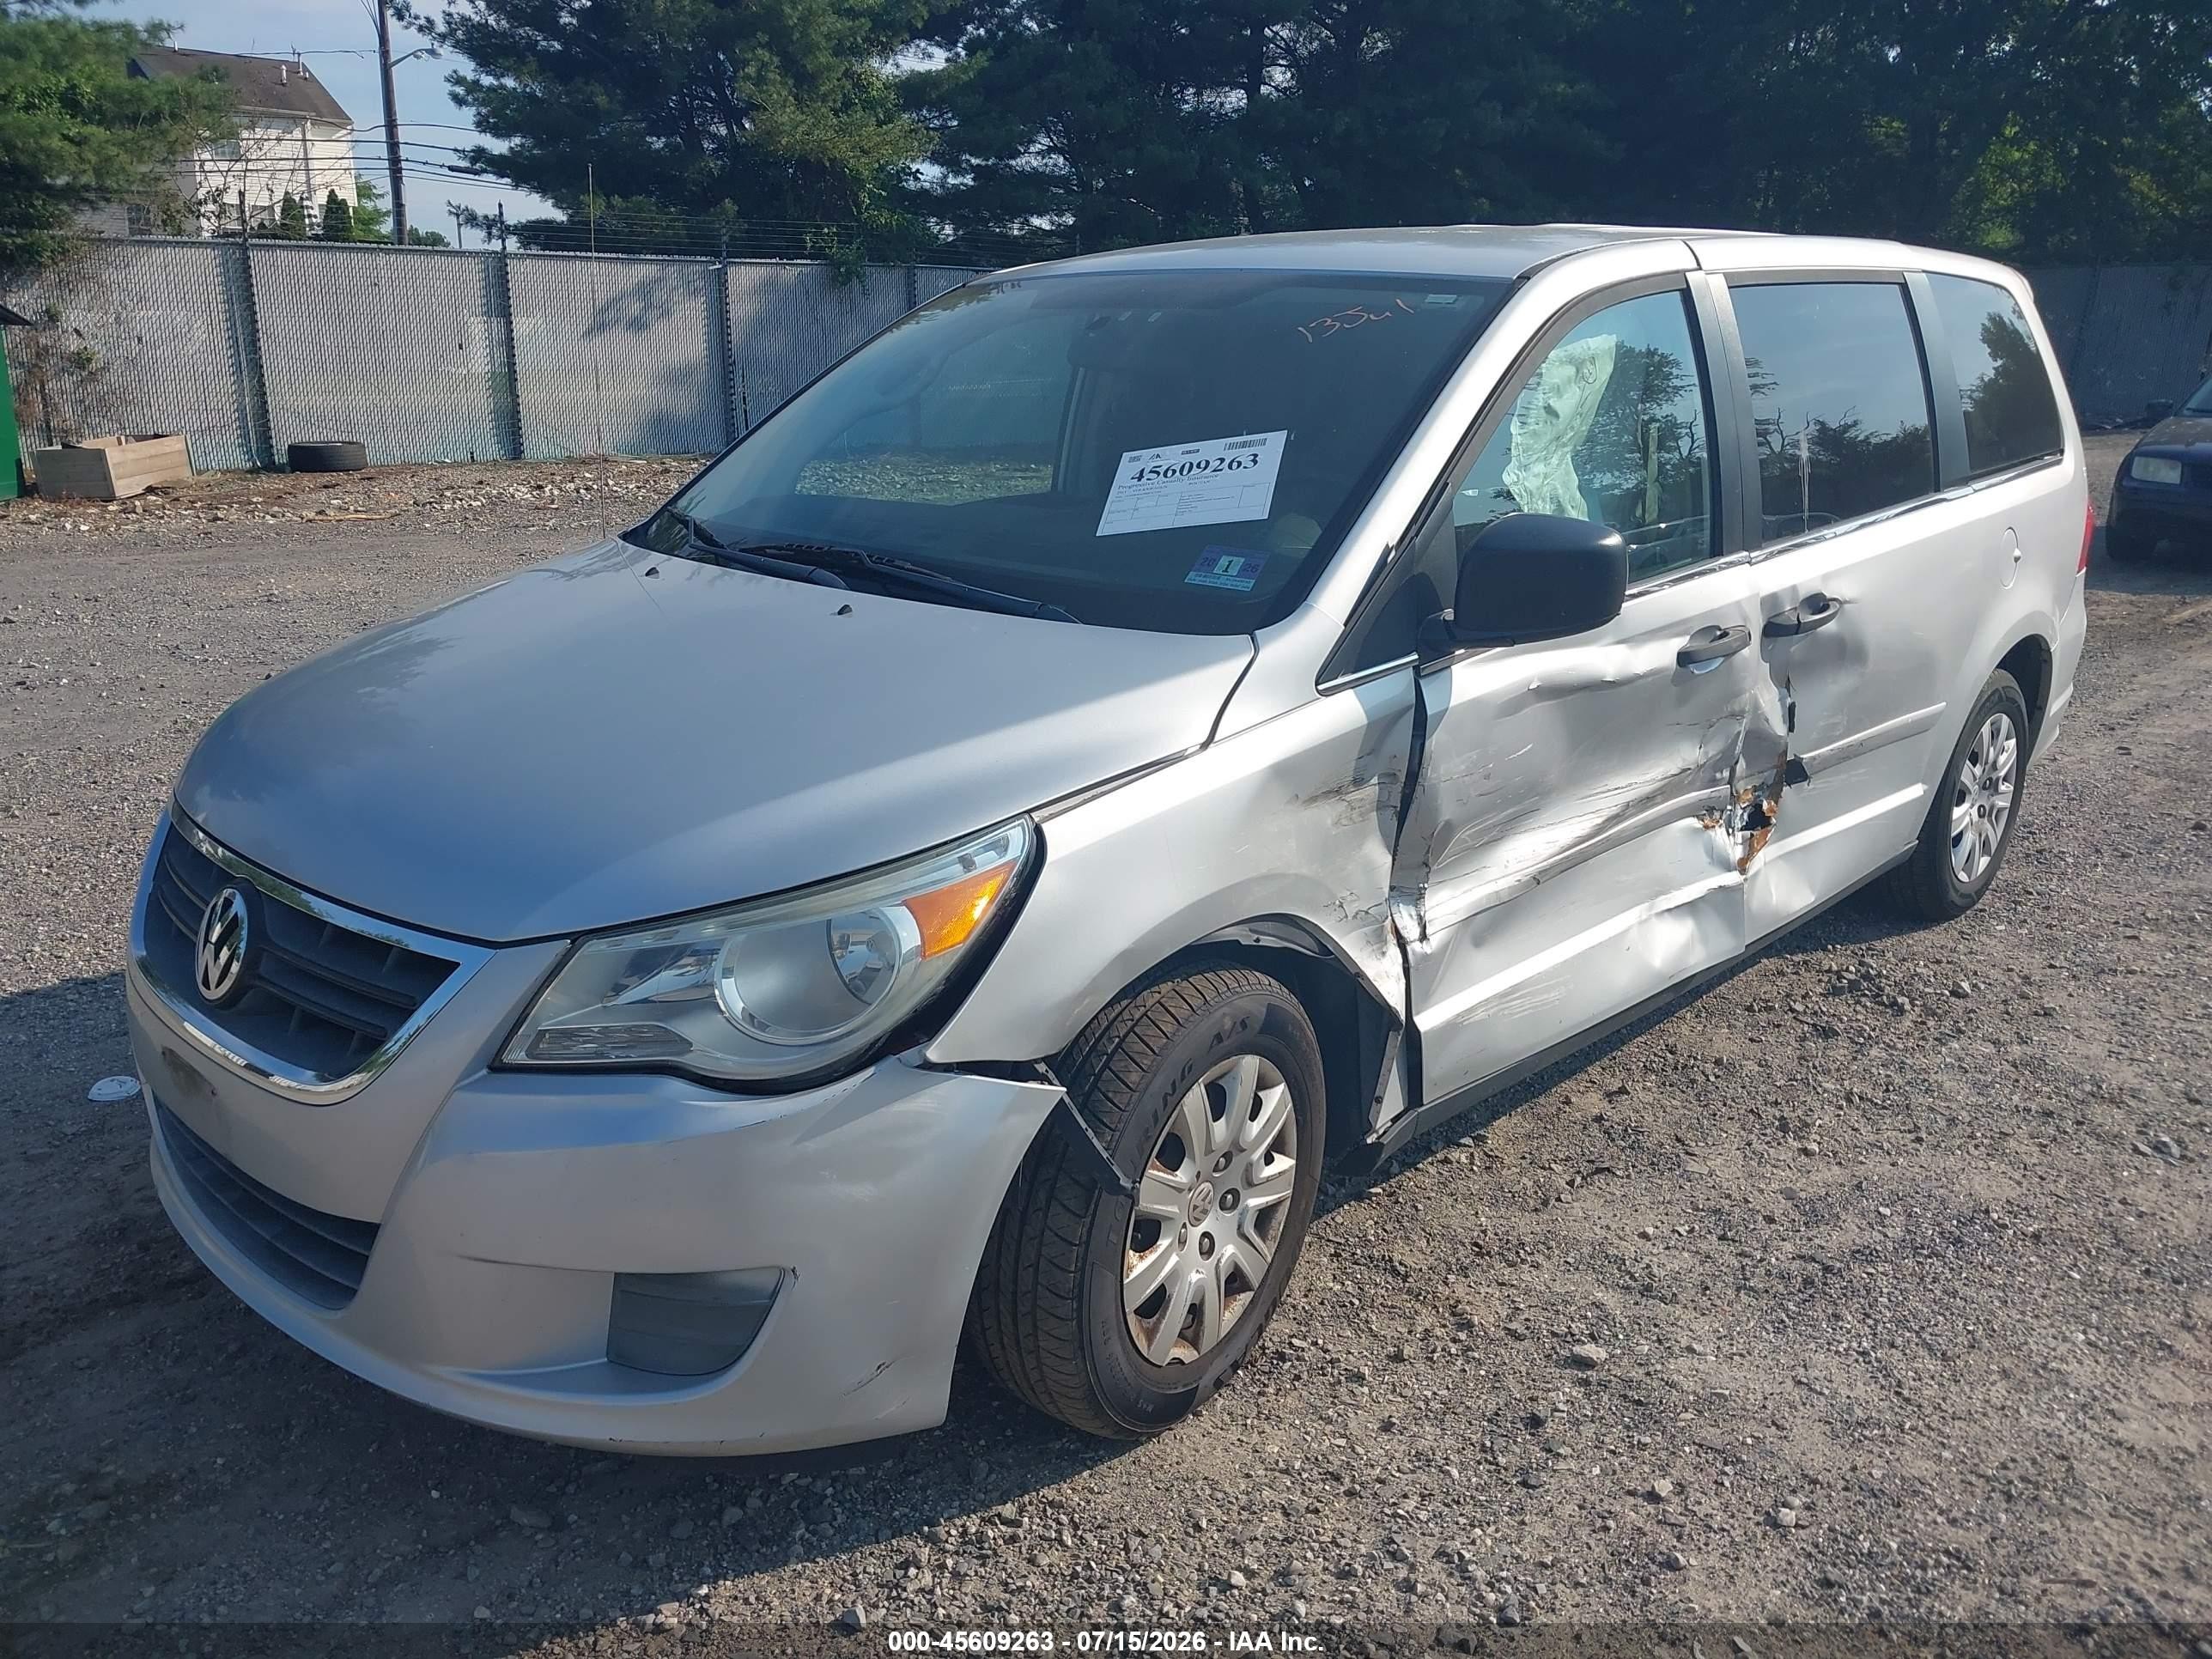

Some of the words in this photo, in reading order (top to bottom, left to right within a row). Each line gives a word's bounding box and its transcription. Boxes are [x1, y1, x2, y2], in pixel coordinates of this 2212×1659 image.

[1130, 452, 1260, 483] 45609263
[1118, 481, 1156, 490] Progressive
[1157, 476, 1184, 486] Casualty
[1187, 472, 1219, 482] Insurance
[1221, 558, 1234, 574] 1
[1207, 1016, 1250, 1054] A/S
